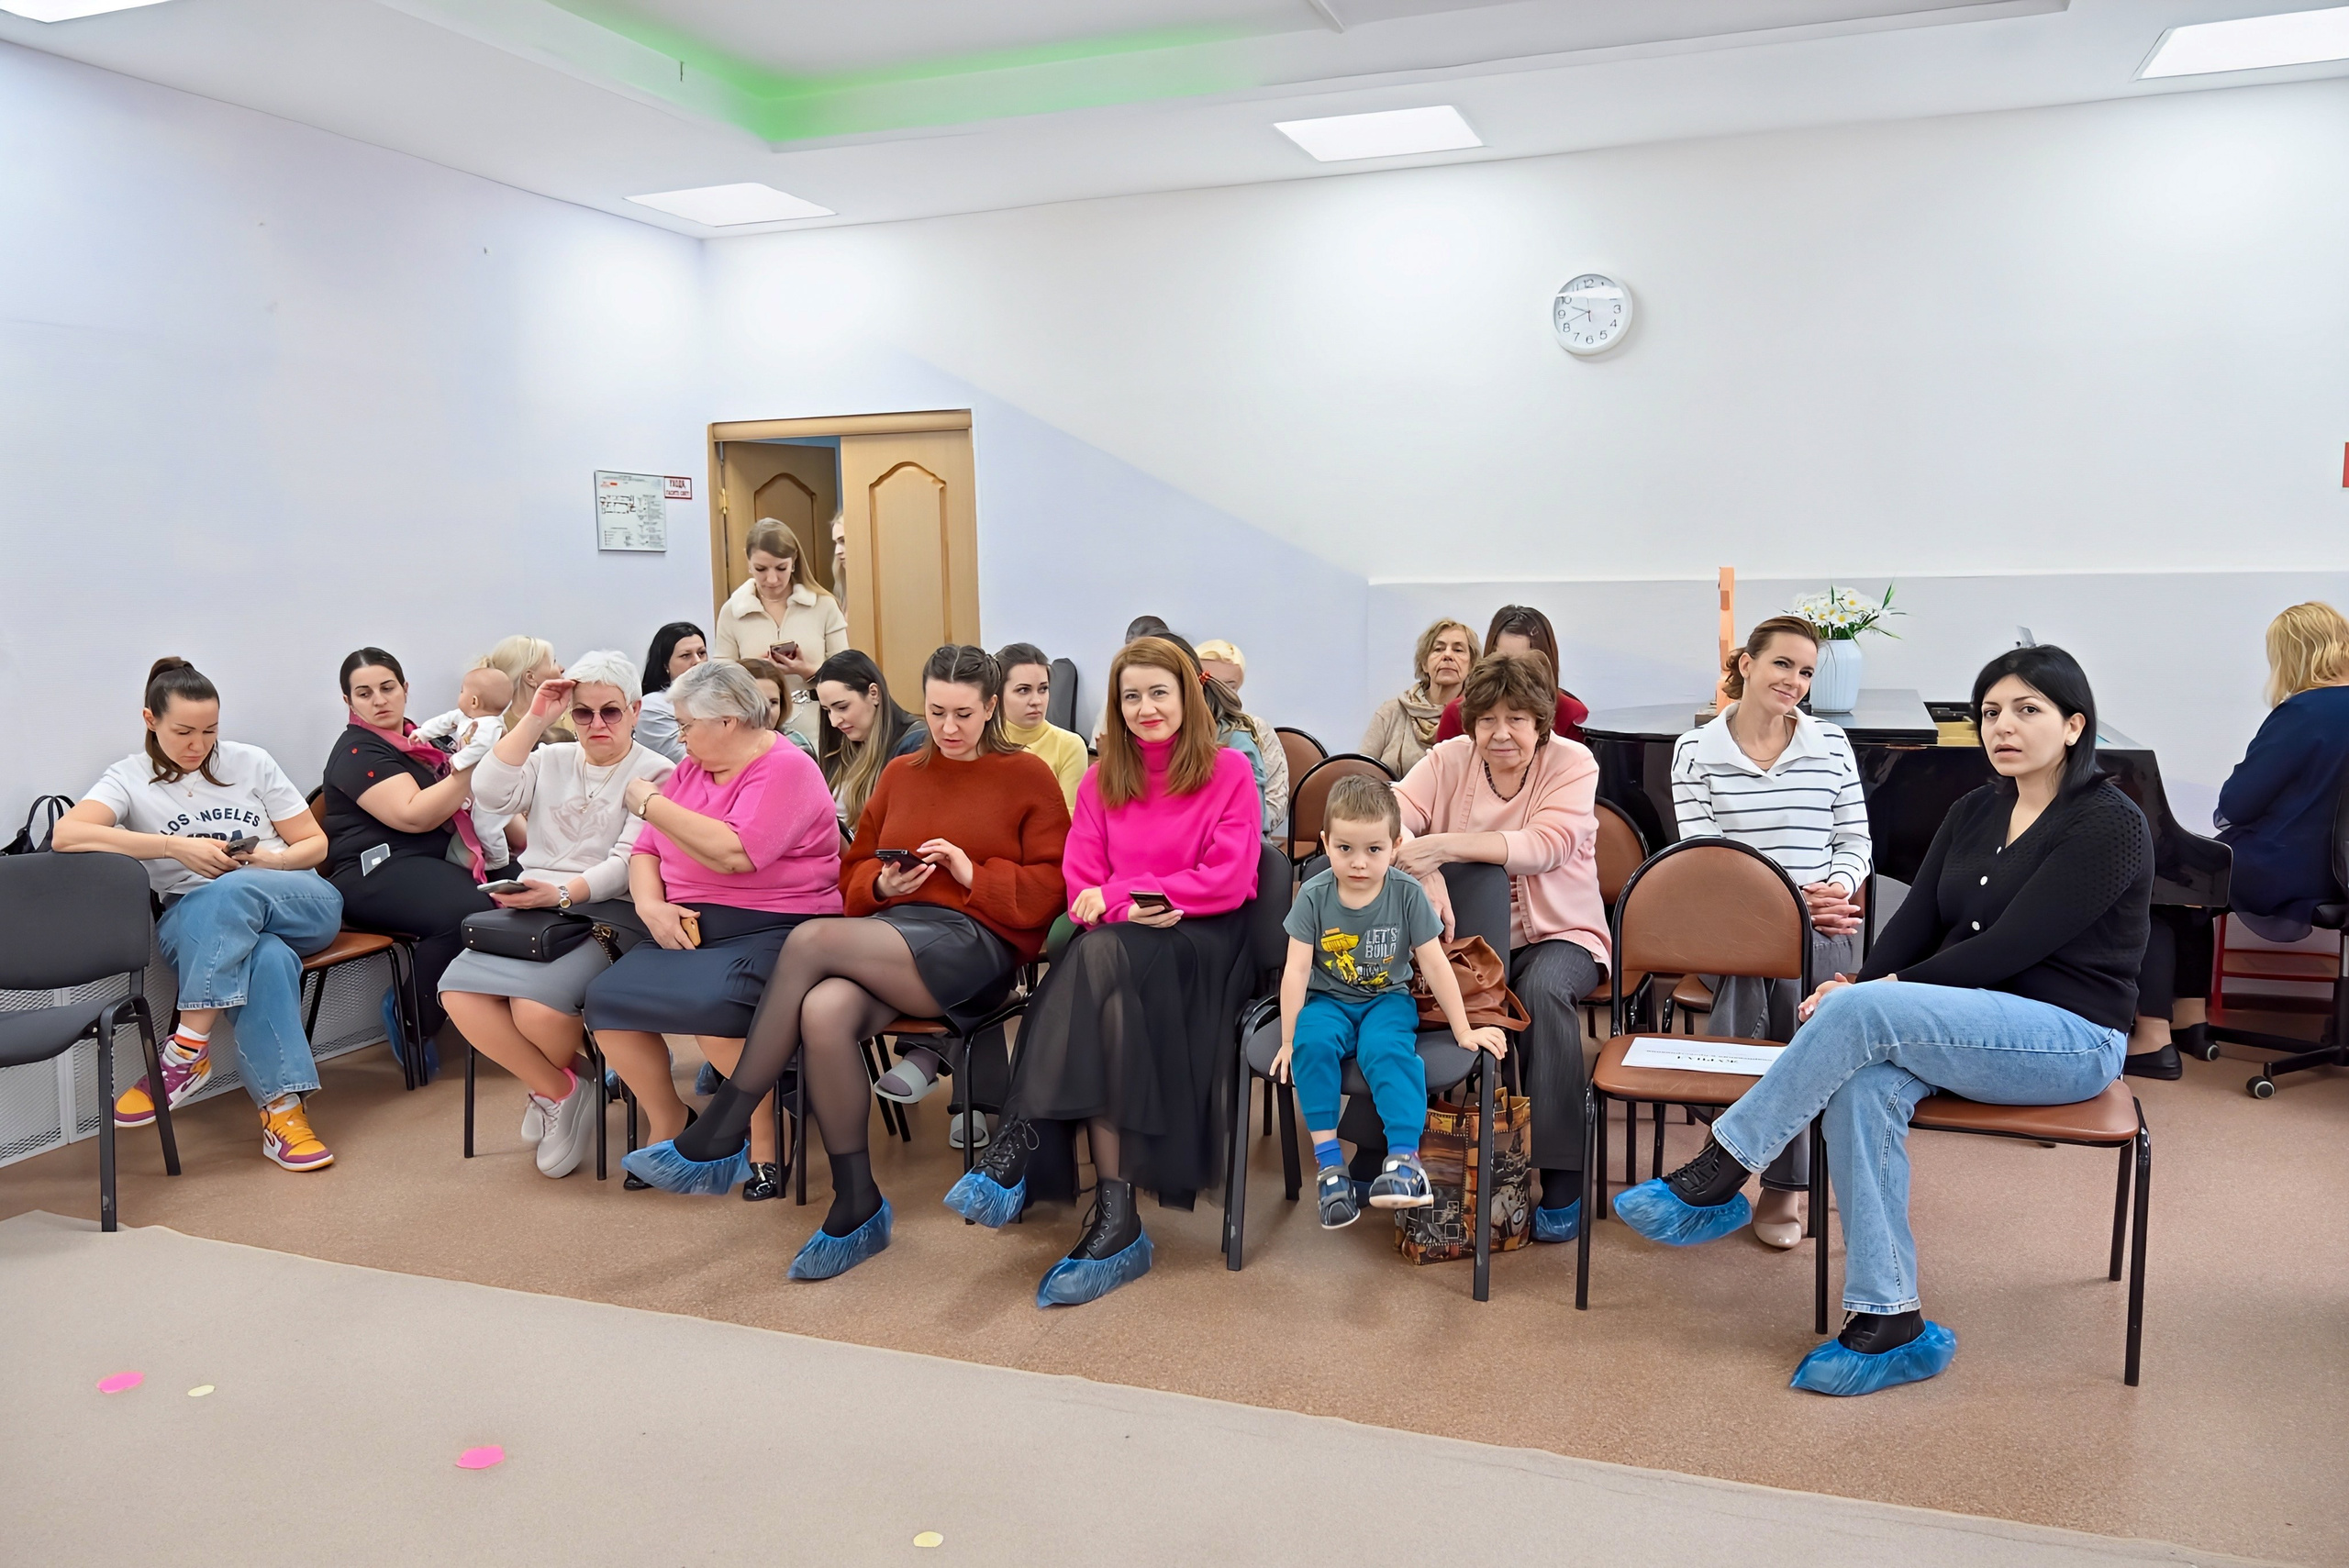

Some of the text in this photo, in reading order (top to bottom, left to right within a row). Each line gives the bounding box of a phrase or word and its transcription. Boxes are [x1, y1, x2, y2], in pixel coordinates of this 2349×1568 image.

[1584, 278, 1595, 289] 12
[1559, 295, 1573, 306] 10
[1557, 309, 1566, 319] 9
[1613, 304, 1622, 315] 3
[1562, 322, 1571, 333] 8
[1609, 318, 1618, 328] 4
[1573, 332, 1580, 342] 7
[1599, 329, 1608, 339] 5
[1586, 335, 1595, 345] 6
[160, 814, 190, 837] LOS
[195, 807, 261, 828] NGELES
[1365, 927, 1398, 945] LET'S
[1364, 942, 1397, 959] BUILD
